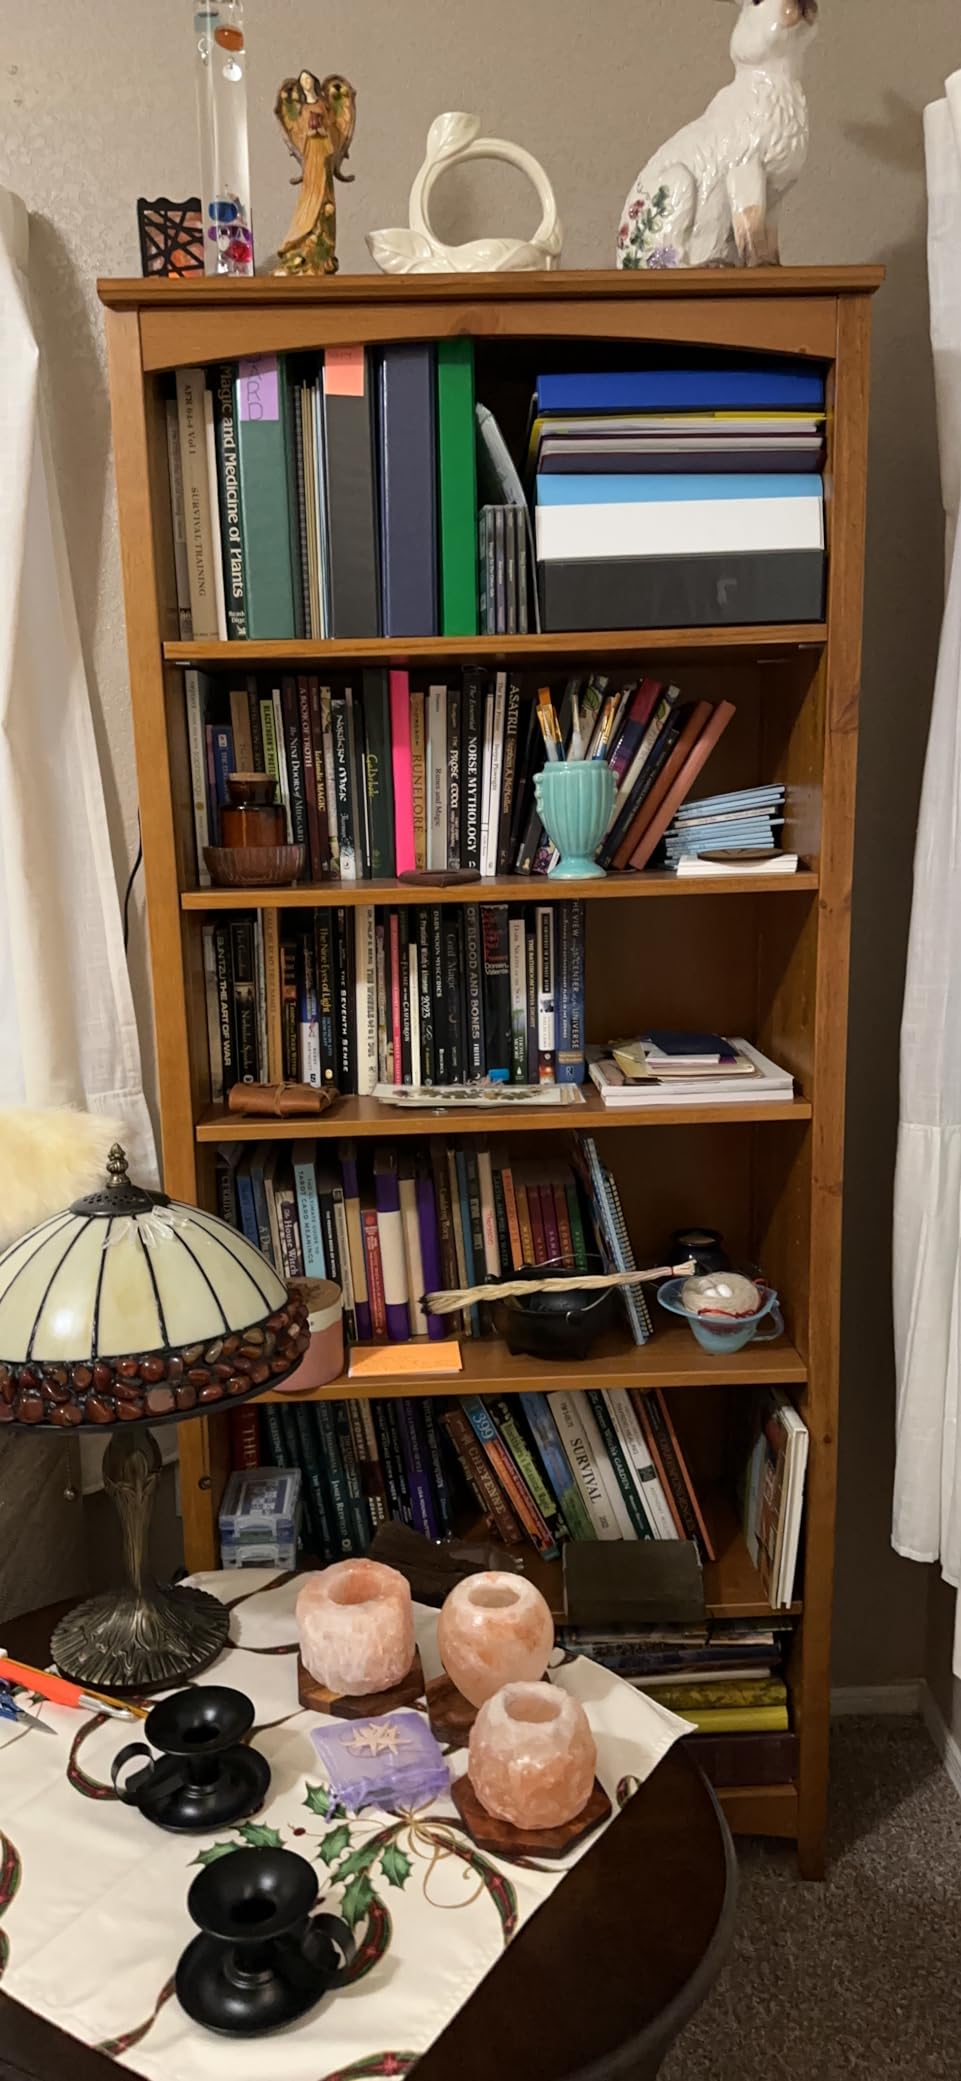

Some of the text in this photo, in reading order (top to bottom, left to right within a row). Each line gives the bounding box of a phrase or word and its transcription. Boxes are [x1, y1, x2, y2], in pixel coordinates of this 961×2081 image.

[216, 364, 234, 414] Magic
[222, 418, 236, 448] and
[224, 452, 240, 518] Medicine
[190, 486, 204, 542] SURVIVAL
[228, 526, 242, 544] of
[192, 544, 206, 598] TRAINING
[229, 548, 244, 598] Plants
[506, 684, 520, 735] ASATRU
[288, 738, 299, 760] NINE
[302, 736, 312, 768] TROTH
[467, 736, 478, 776] NORSE
[290, 760, 302, 792] DOORS
[412, 753, 424, 834] RUNELORE
[502, 776, 513, 814] McNallen
[316, 782, 328, 813] MAGIC
[432, 767, 444, 828] Runes and Magic
[466, 776, 478, 854] MYTHOLOGY
[294, 798, 306, 844] MIDGARD
[320, 927, 332, 1014] The Nine Eyes of Light
[445, 933, 456, 992] Cord Magic
[466, 906, 480, 1040] OF BLOOD AND BONES
[571, 914, 580, 1050] VIEW CENTER UNIVERSE
[218, 980, 228, 1000] THE
[420, 994, 431, 1019] 2023
[220, 1002, 229, 1023] ART
[222, 1024, 230, 1039] OF
[340, 989, 349, 1036] SEVENTH
[402, 1001, 410, 1042] CAULDRON
[222, 1040, 232, 1066] WAR
[342, 1038, 350, 1073] SENSE
[283, 1220, 296, 1249] House
[297, 1170, 315, 1264] TAROT CARD MEANINGS
[287, 1248, 300, 1276] Witch
[471, 1412, 495, 1440] 399
[468, 1446, 506, 1514] CHEYENNE
[569, 1436, 602, 1504] SURVIVAL
[613, 1456, 631, 1491] GARDEN
